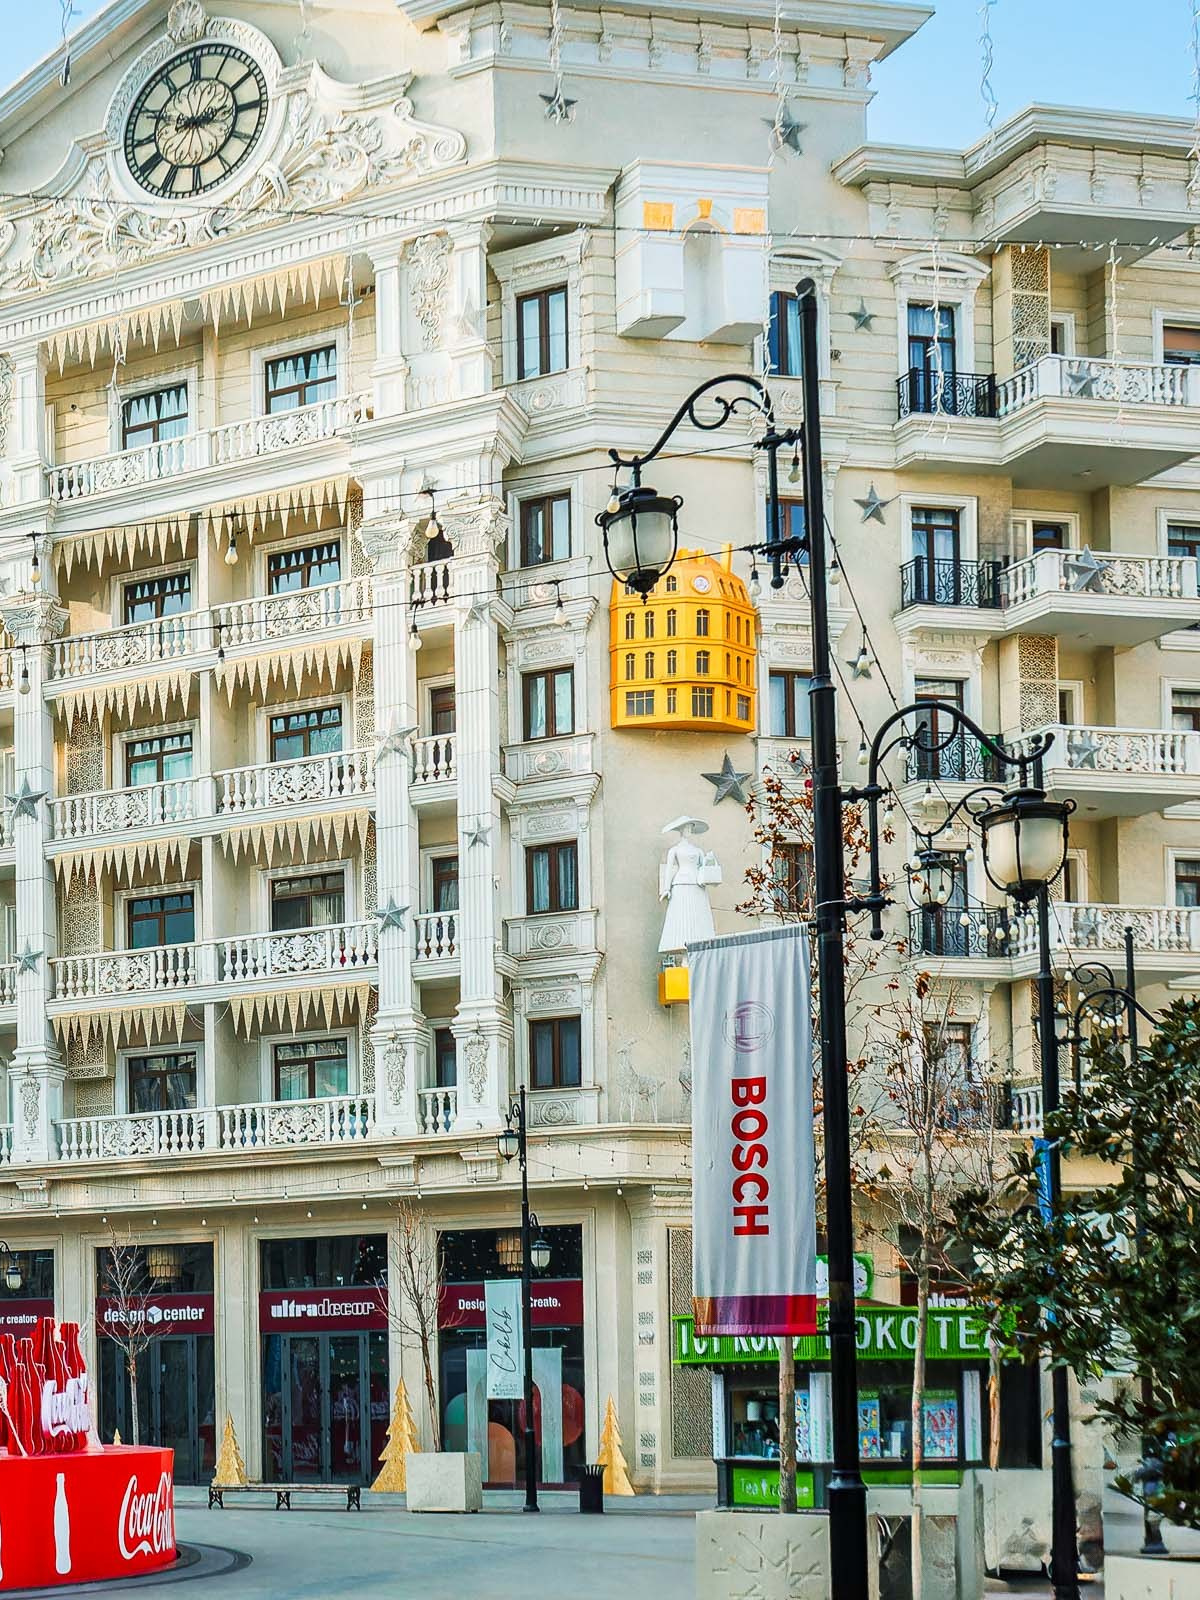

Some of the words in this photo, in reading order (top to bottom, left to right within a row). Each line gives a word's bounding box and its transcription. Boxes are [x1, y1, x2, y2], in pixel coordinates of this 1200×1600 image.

[731, 1076, 769, 1236] BOSCH
[164, 1305, 205, 1321] center
[271, 1298, 375, 1318] ultradecor
[458, 1298, 485, 1311] Desig
[6, 1314, 38, 1324] creators
[825, 1315, 920, 1350] OKO
